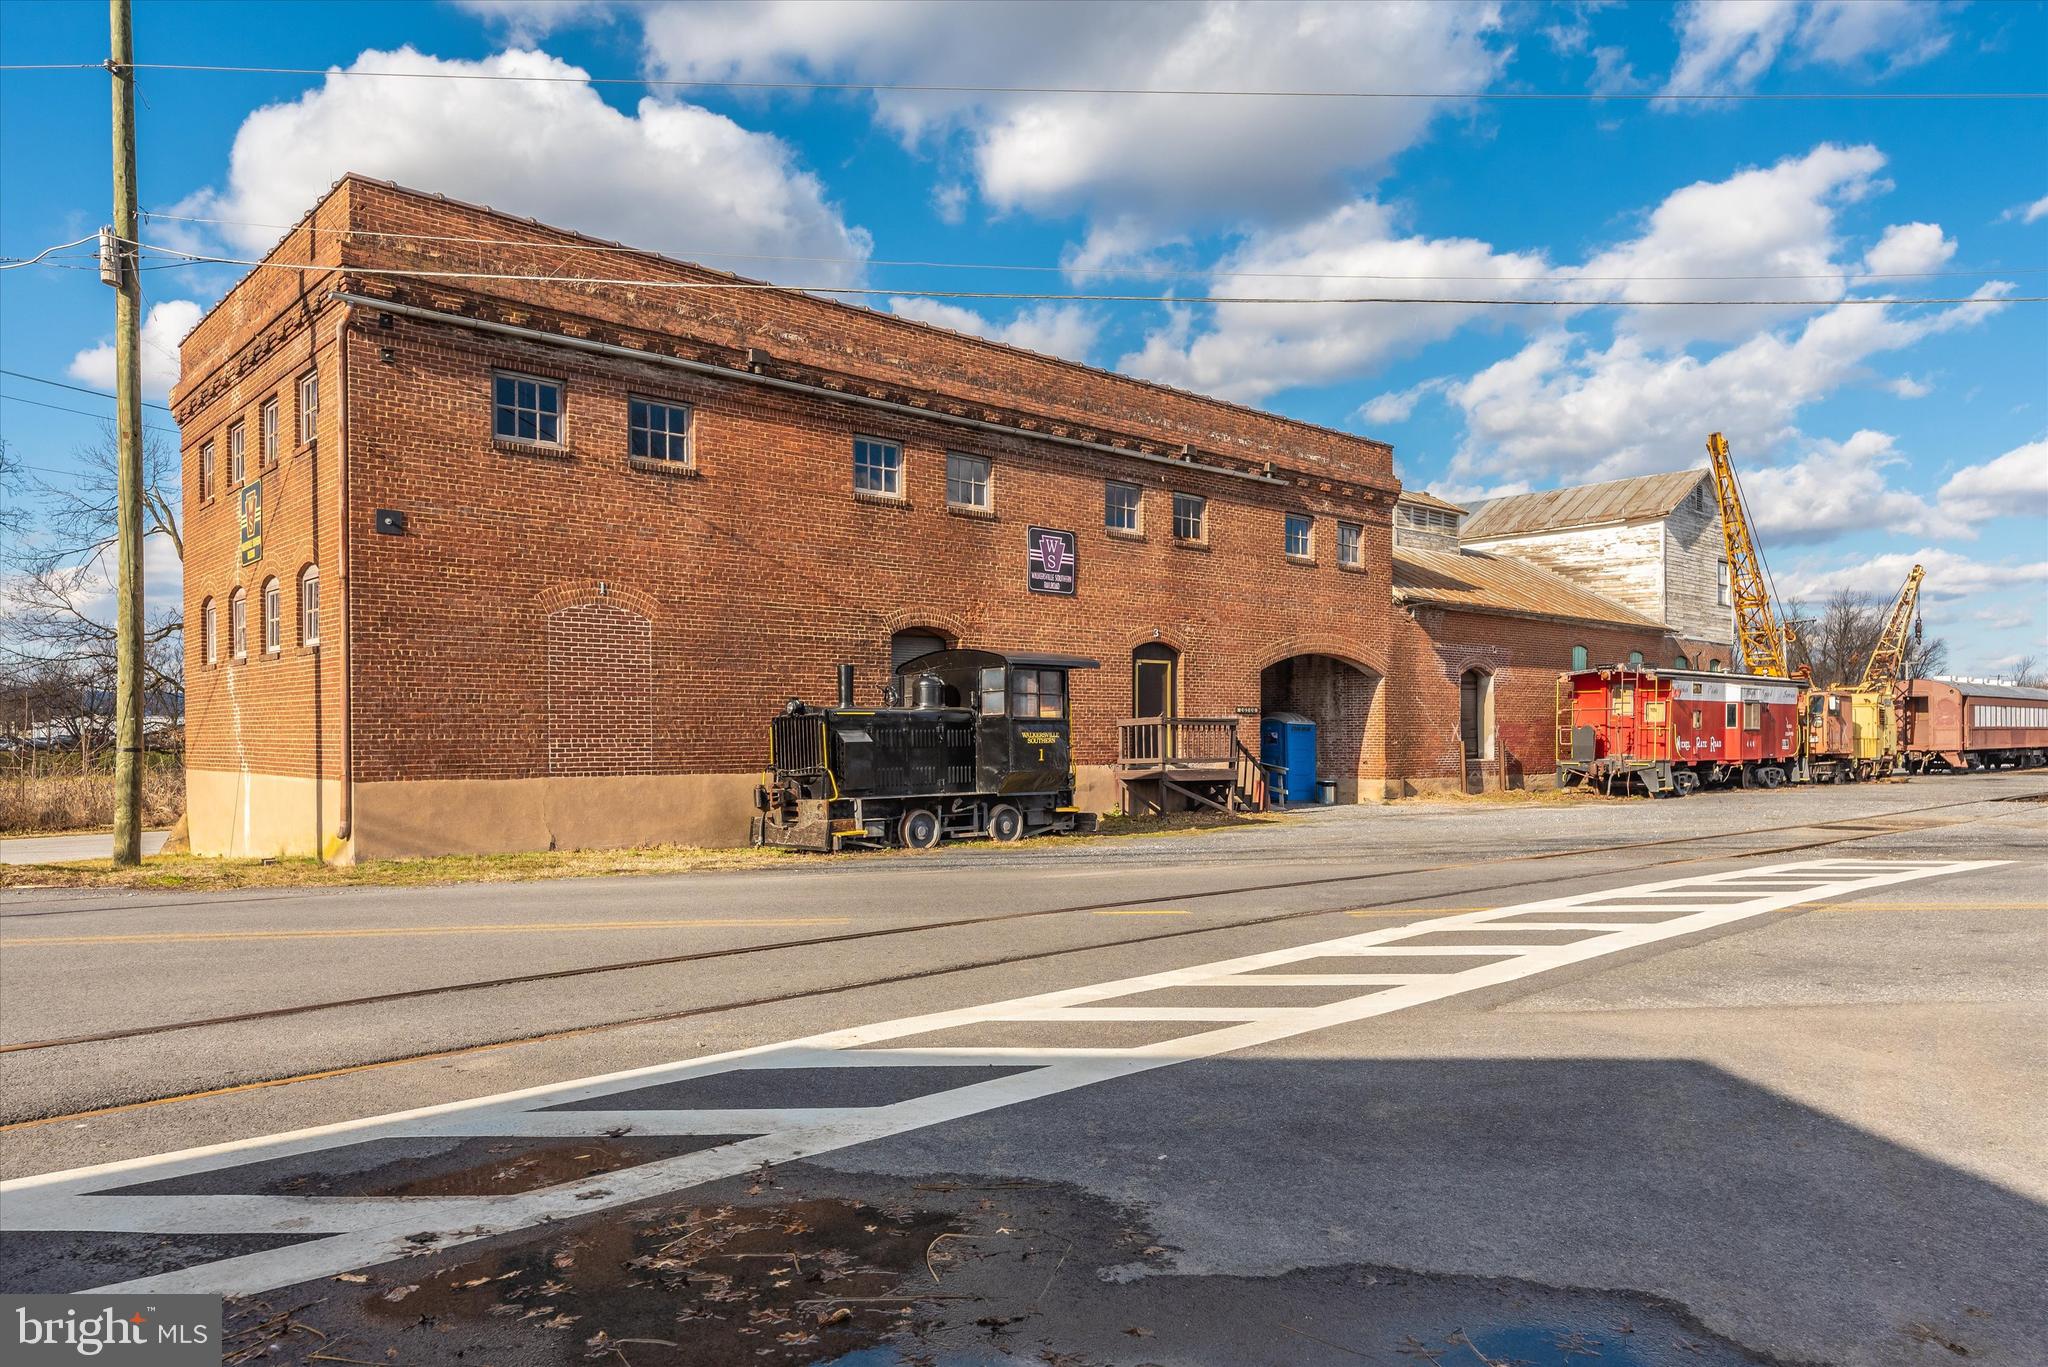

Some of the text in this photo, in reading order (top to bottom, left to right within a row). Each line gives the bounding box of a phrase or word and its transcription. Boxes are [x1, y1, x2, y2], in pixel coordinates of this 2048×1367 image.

[1045, 539, 1059, 553] W
[1047, 554, 1056, 569] S
[1153, 628, 1159, 637] 3
[1038, 748, 1045, 762] 1
